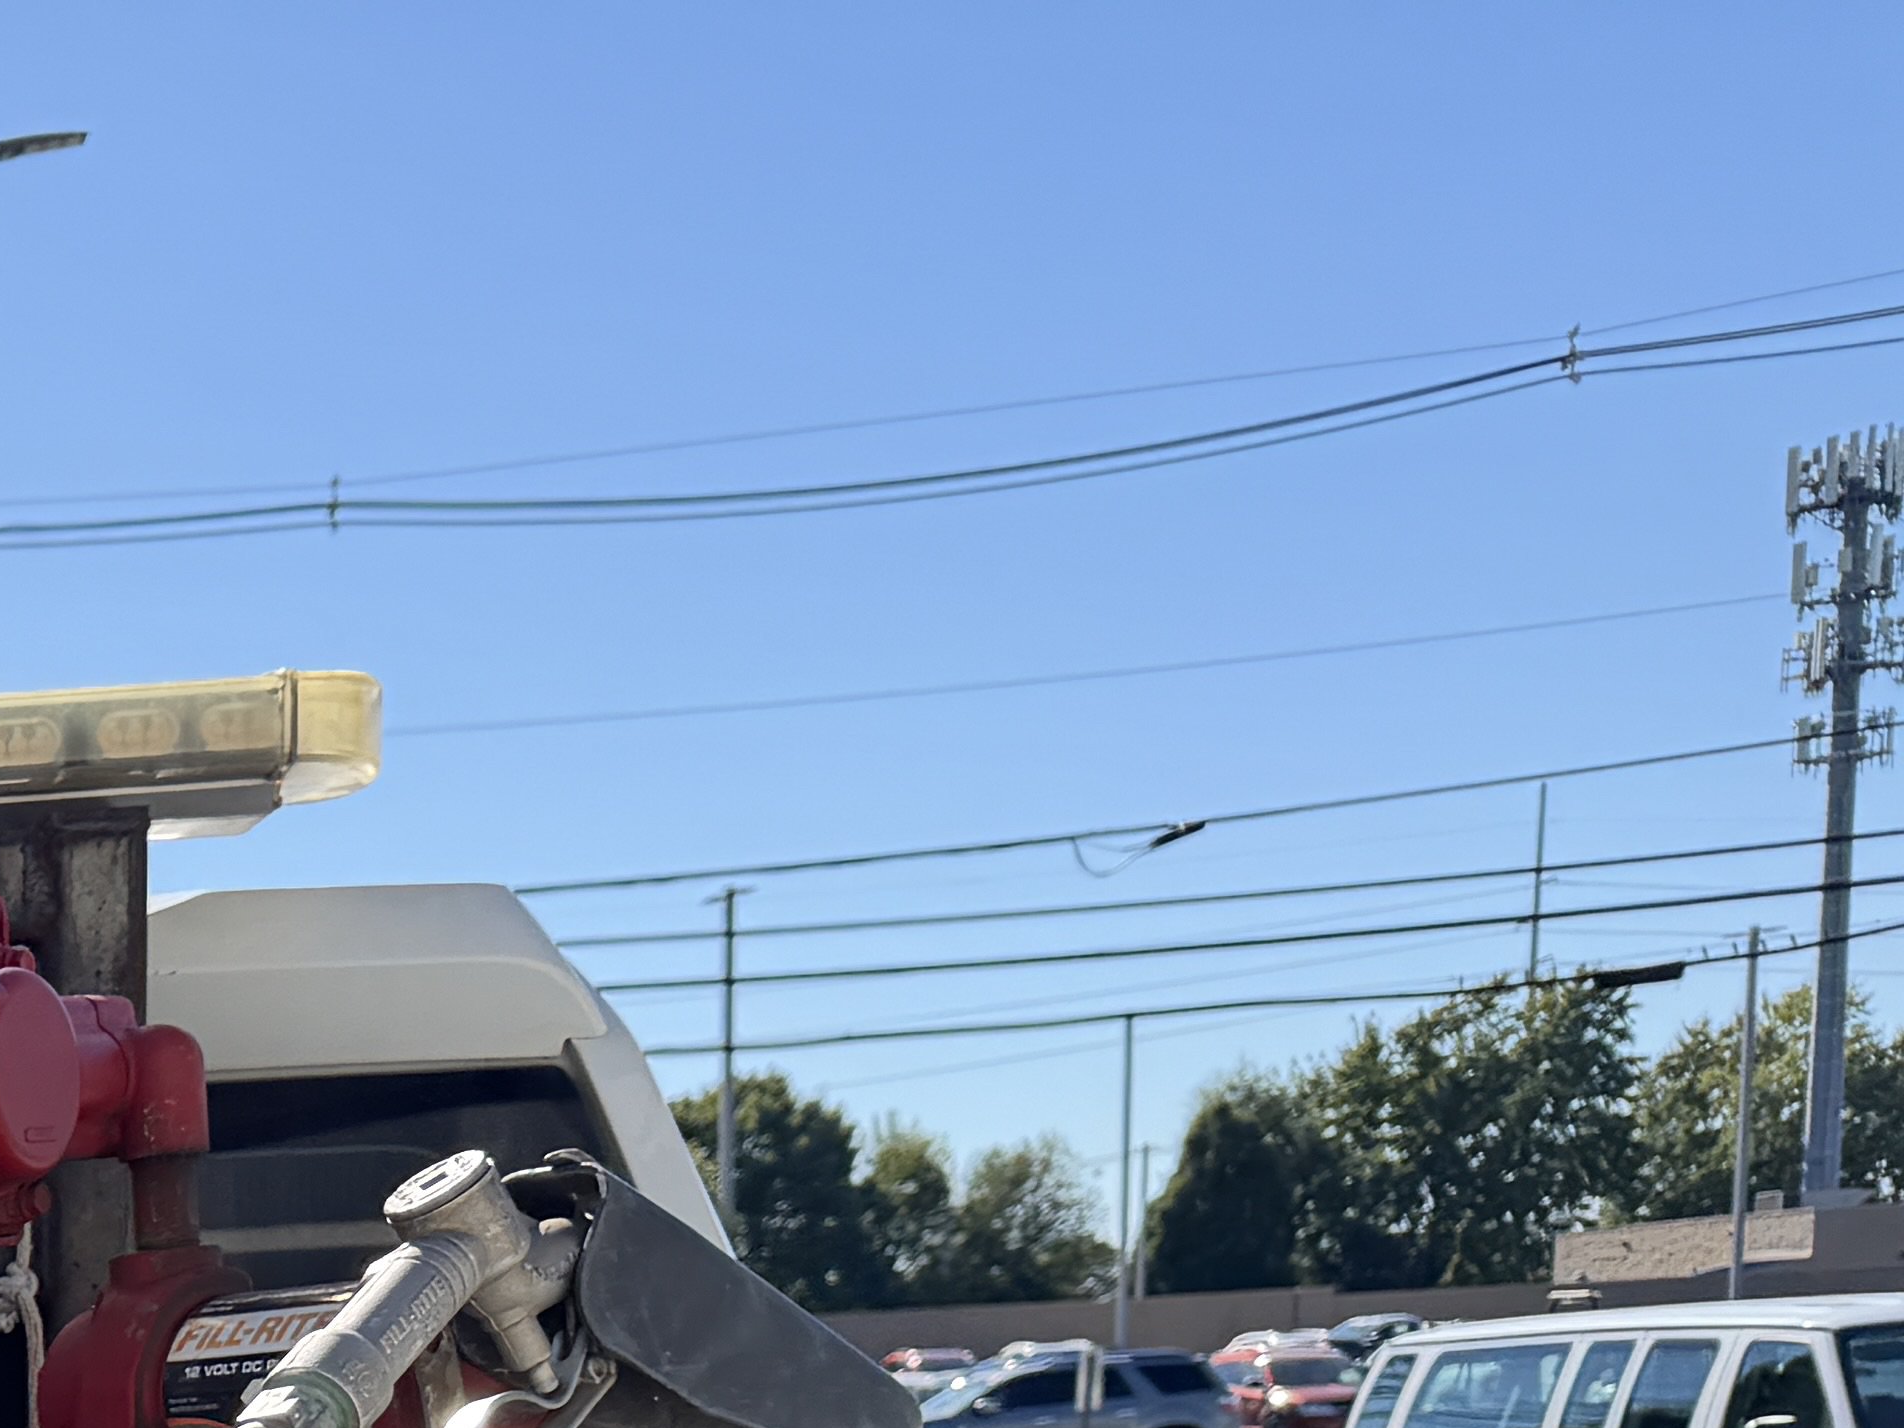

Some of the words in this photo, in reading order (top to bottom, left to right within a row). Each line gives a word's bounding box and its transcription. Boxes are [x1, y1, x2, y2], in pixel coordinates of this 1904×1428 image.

[379, 1275, 446, 1354] FILL-RITE
[184, 1366, 201, 1379] 12
[204, 1362, 239, 1378] VOLT
[242, 1360, 263, 1374] DC
